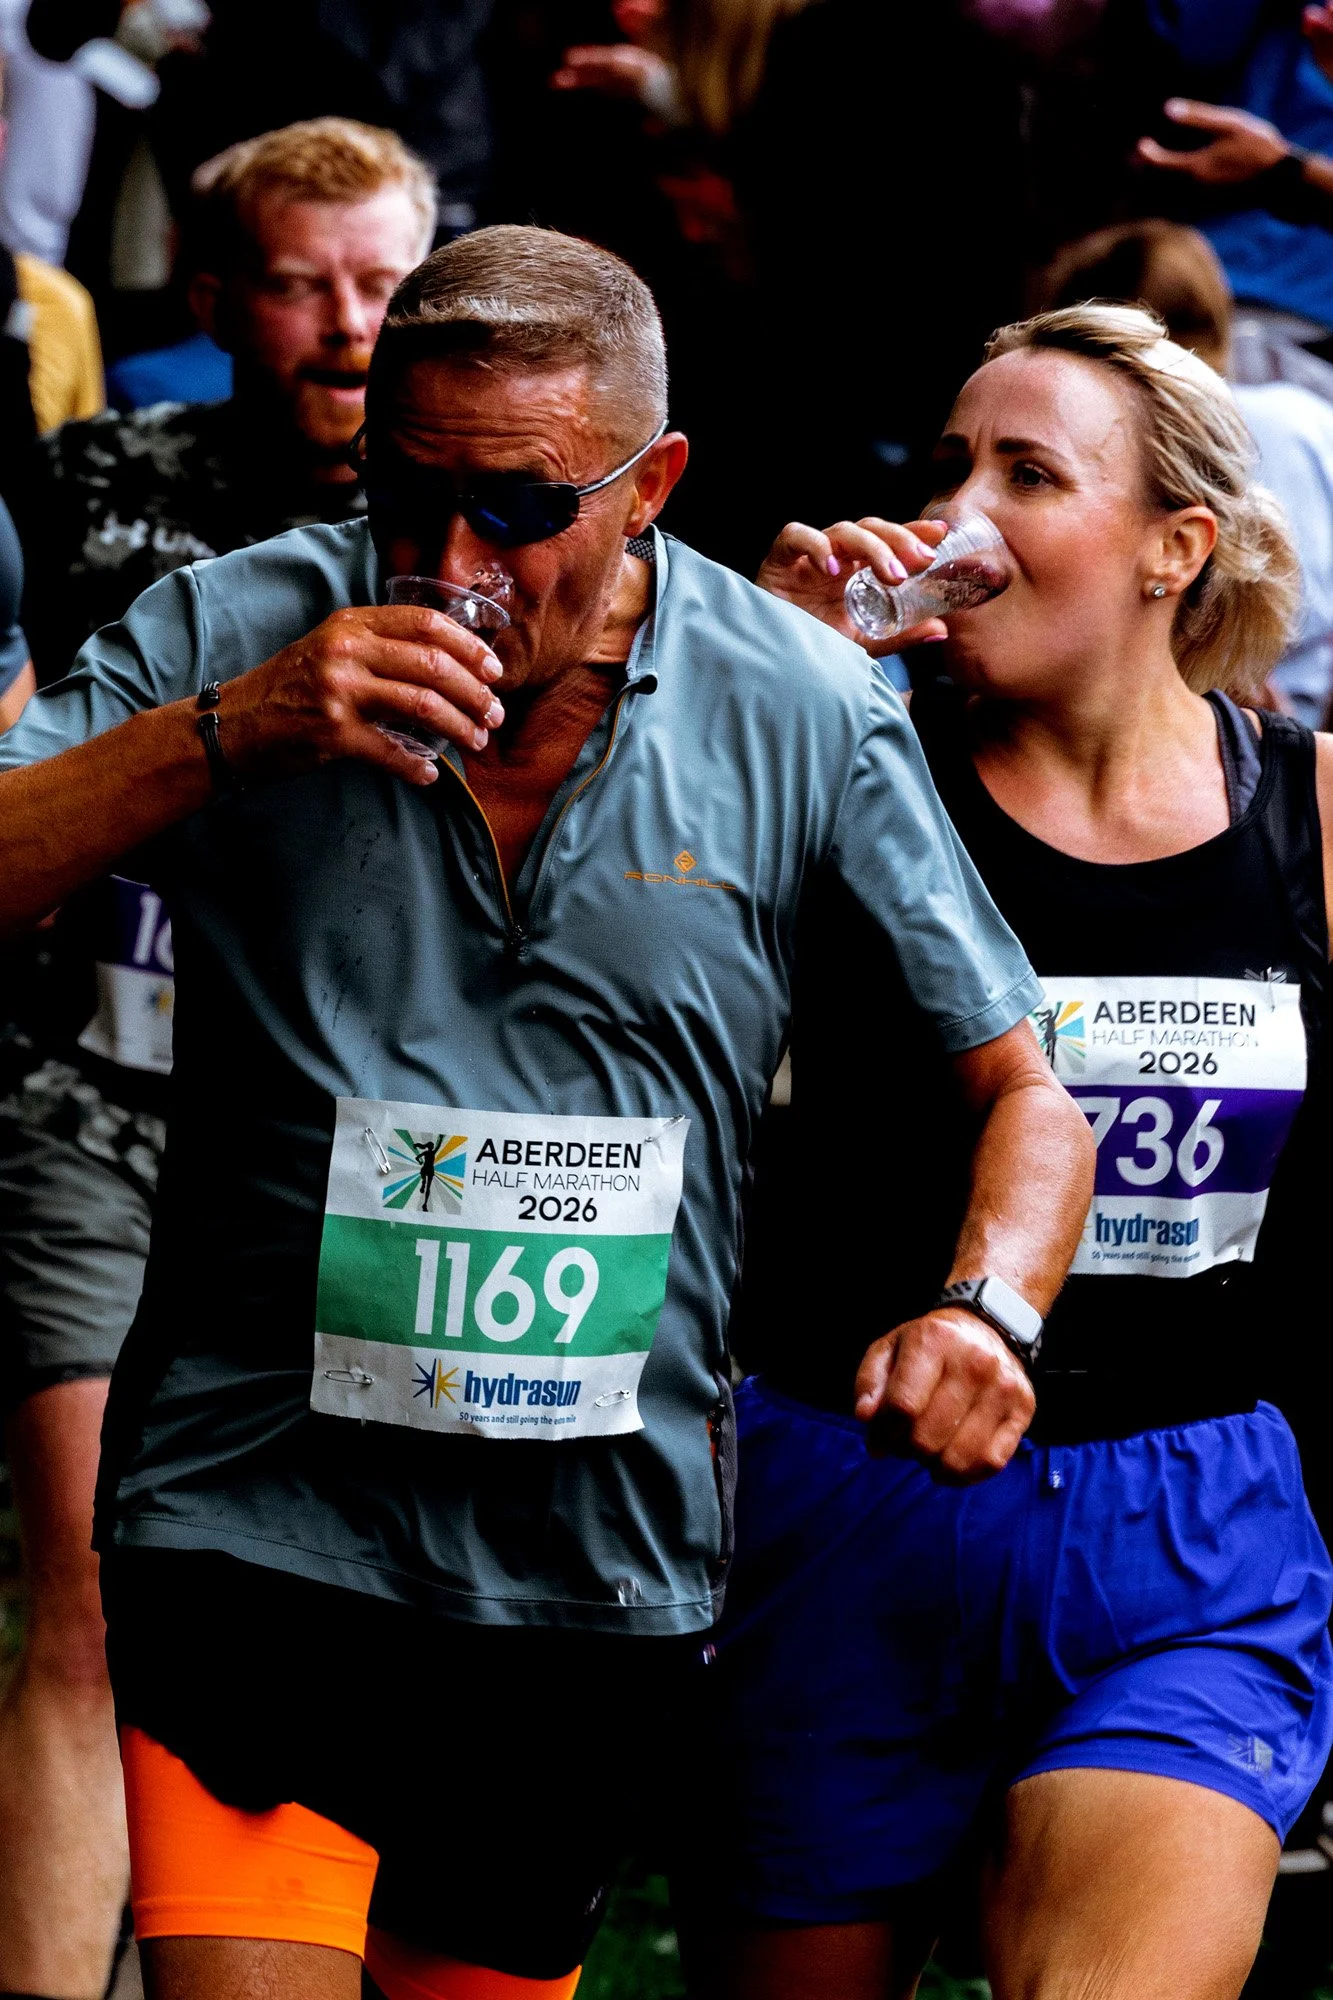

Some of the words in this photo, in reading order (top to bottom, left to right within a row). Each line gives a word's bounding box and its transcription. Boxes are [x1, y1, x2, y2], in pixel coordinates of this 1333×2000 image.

[1092, 1000, 1256, 1027] ABERDEEN
[1092, 1029, 1145, 1047] HALF
[1149, 1030, 1260, 1048] MARATHO
[1138, 1050, 1219, 1076] 2026
[475, 1137, 643, 1169] ABERDEEN
[472, 1168, 528, 1188] HALF
[533, 1171, 641, 1193] MARATHON
[517, 1194, 598, 1223] 2026
[414, 1237, 600, 1344] 1169
[463, 1369, 582, 1409] hydrasun
[459, 1411, 470, 1421] 50
[470, 1414, 490, 1424] years
[491, 1414, 505, 1424] and
[505, 1415, 519, 1424] still
[520, 1415, 539, 1426] going
[540, 1414, 553, 1425] the
